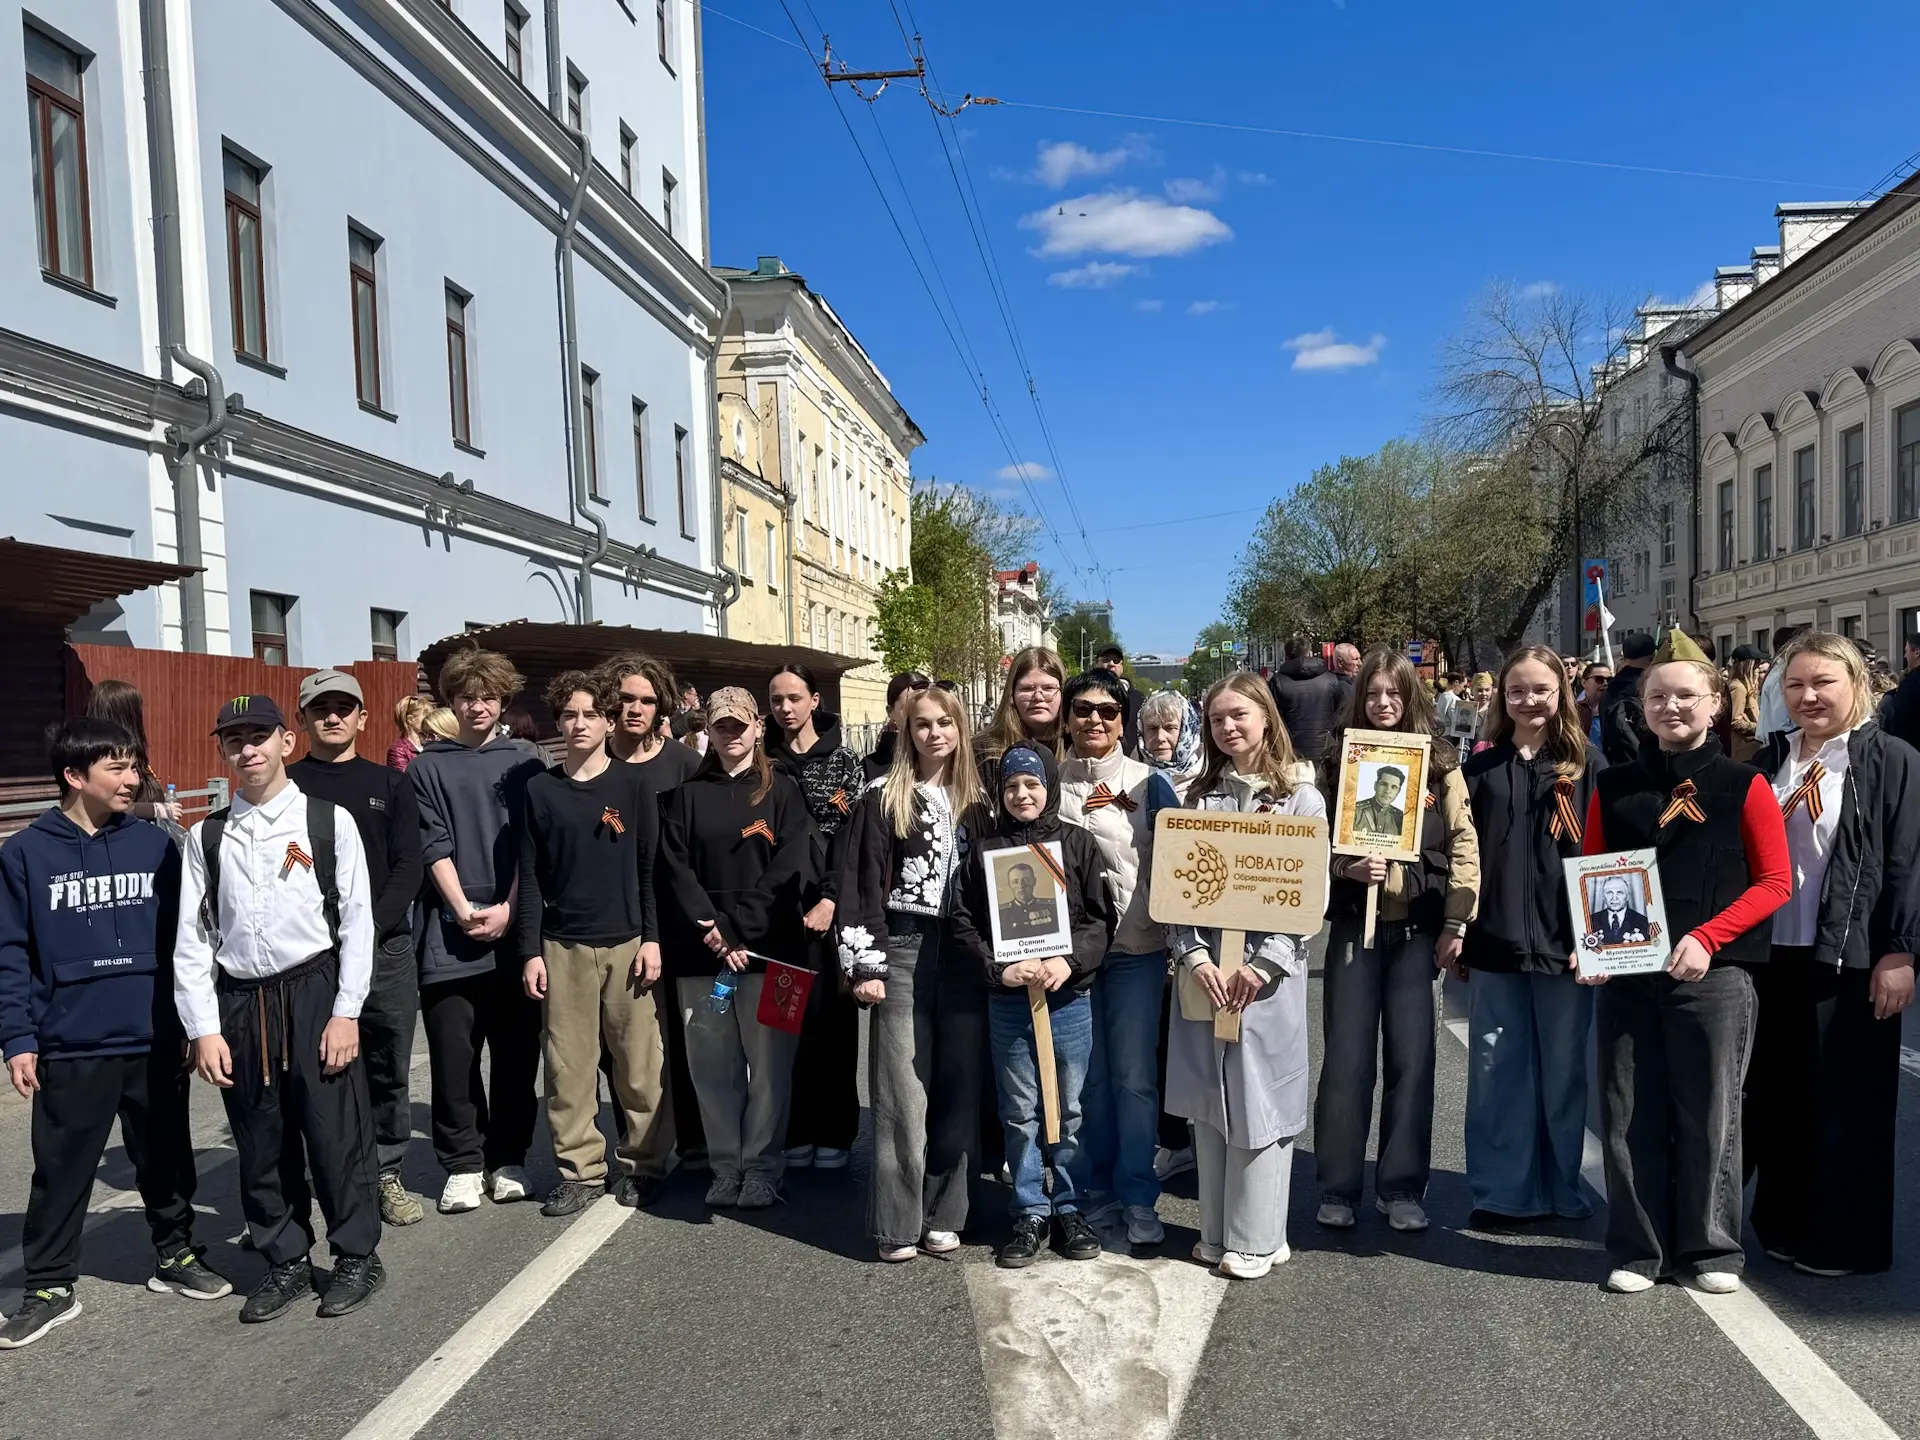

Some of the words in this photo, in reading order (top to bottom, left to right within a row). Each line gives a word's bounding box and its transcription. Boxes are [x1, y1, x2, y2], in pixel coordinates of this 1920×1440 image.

[1166, 817, 1271, 835] БЕССМЕРТНЫЙ
[1275, 824, 1316, 838] ПОЛК
[1234, 855, 1304, 873] НОВАТОР
[1233, 873, 1303, 885] Образовательный
[1233, 884, 1257, 892] центр
[1018, 939, 1045, 947] Осянин
[997, 949, 1022, 958] Сергей
[1023, 944, 1069, 955] Филиппович
